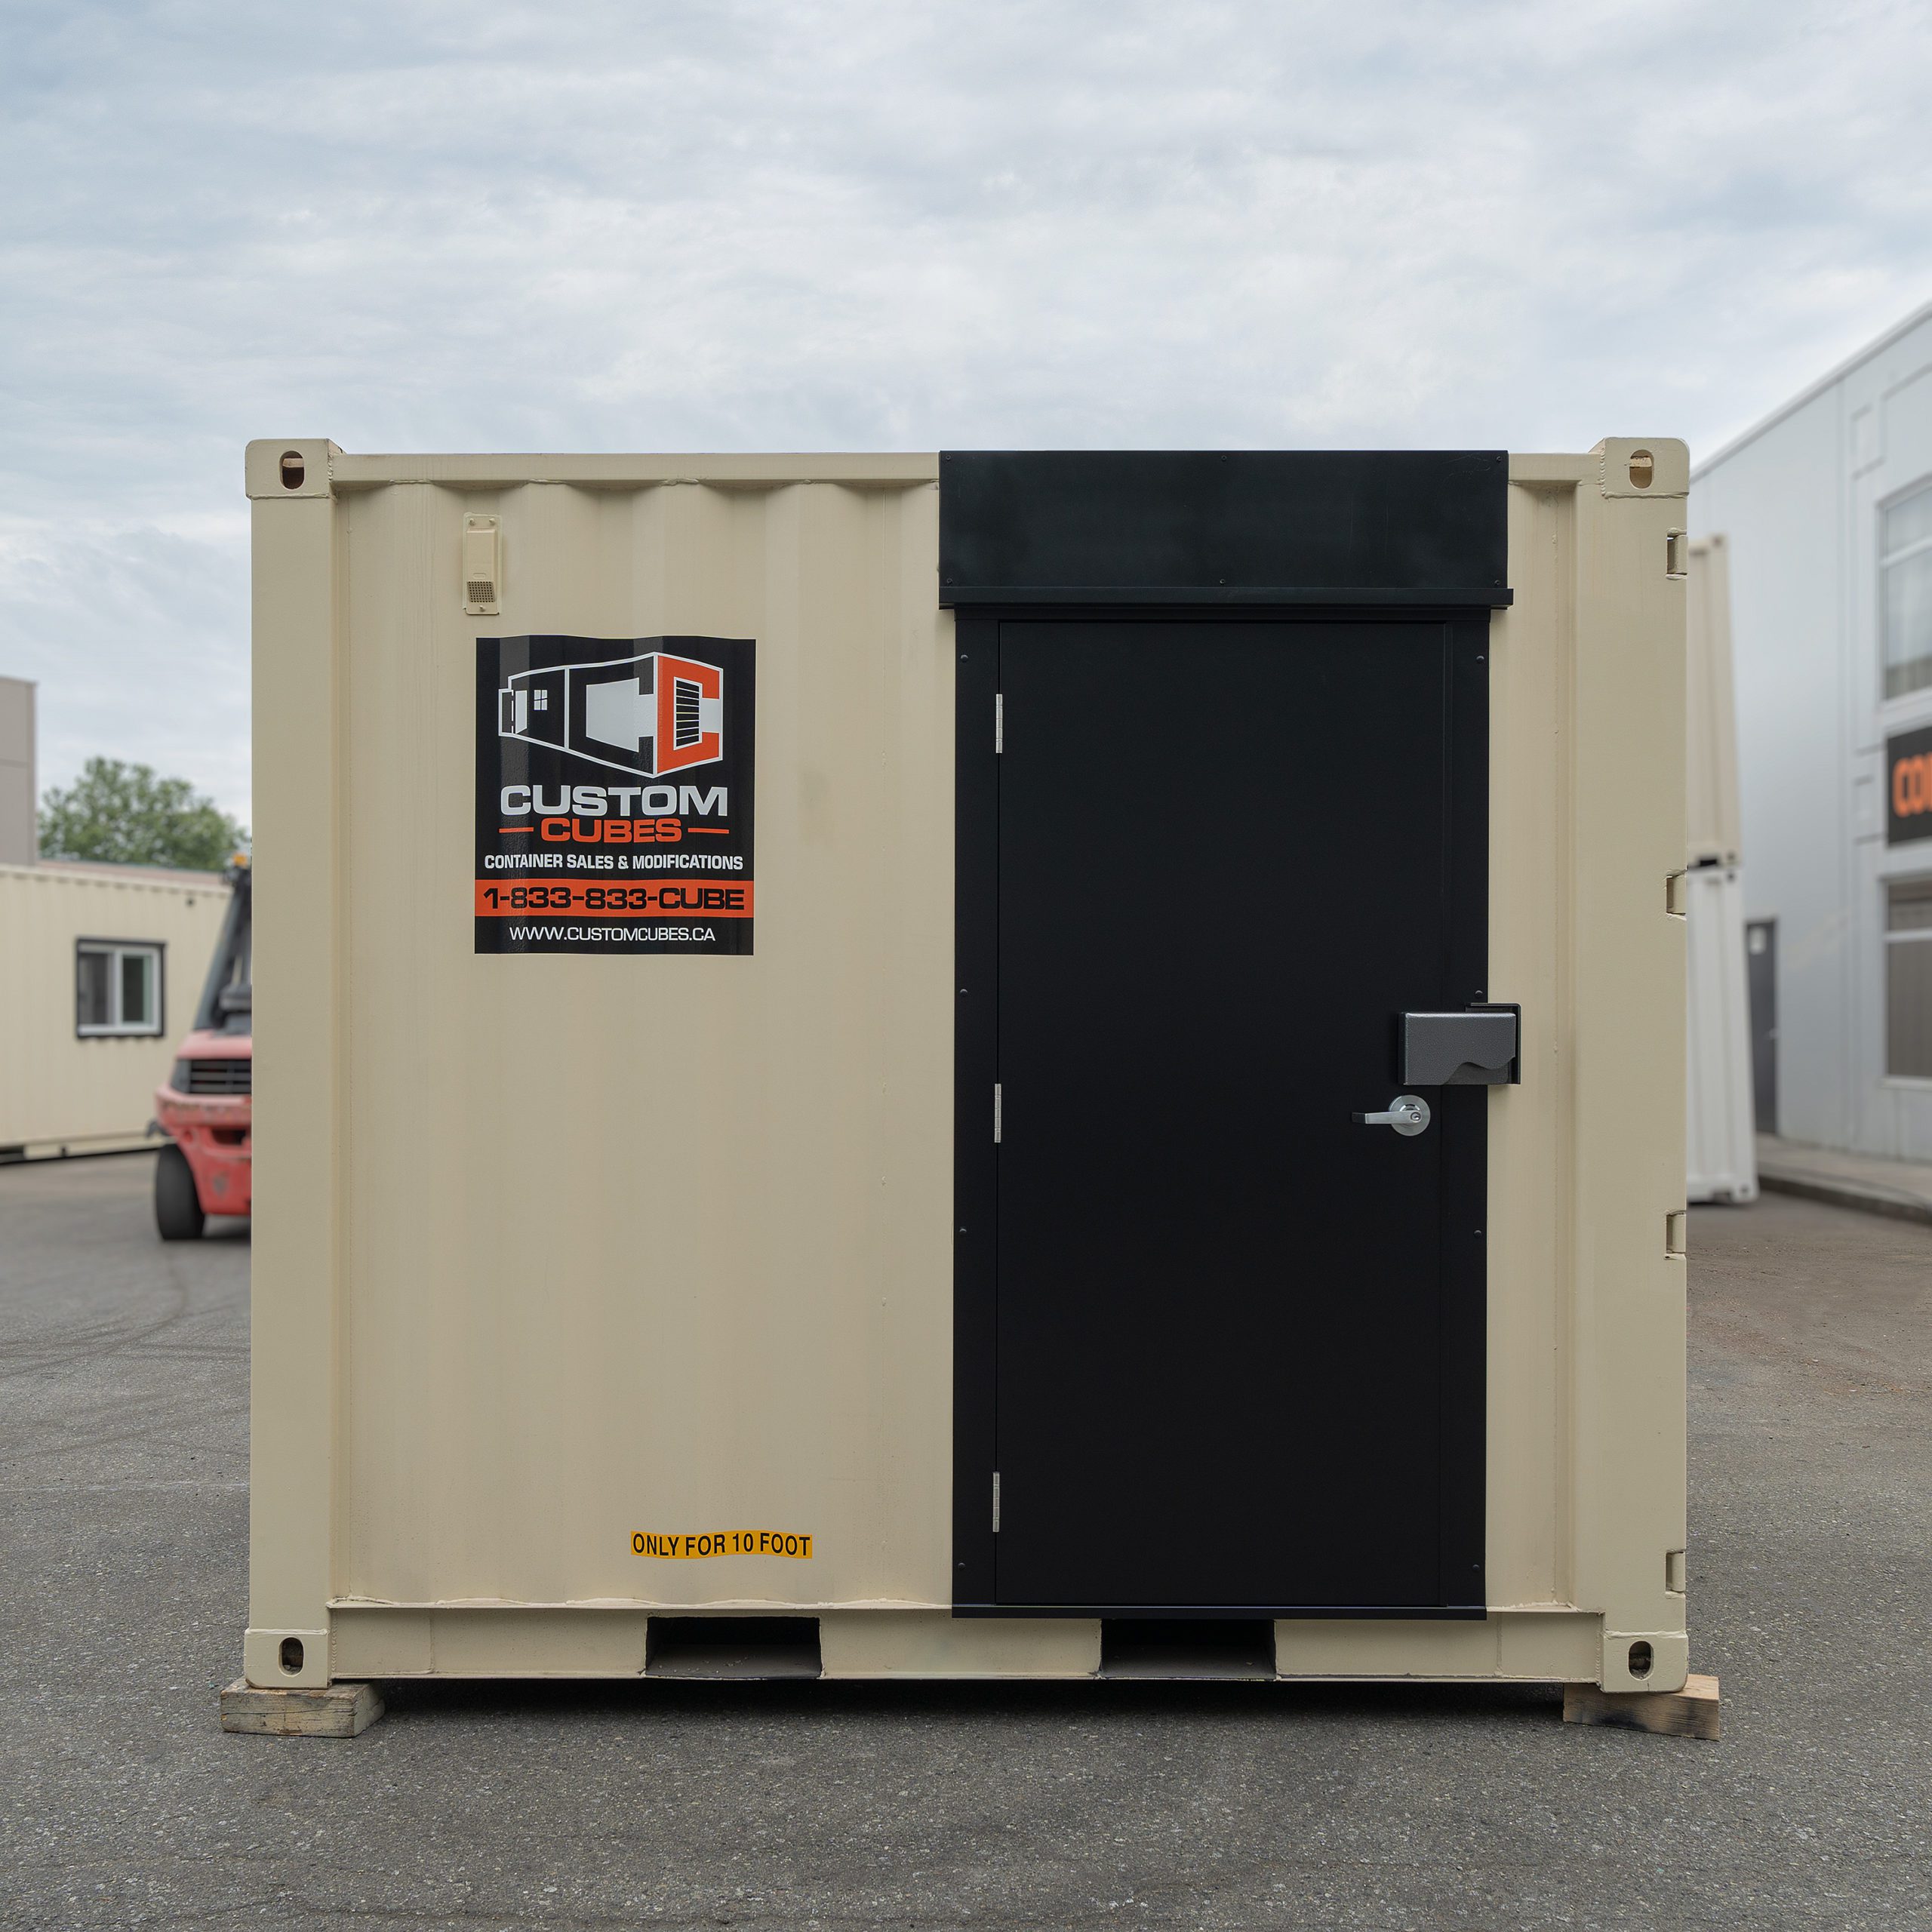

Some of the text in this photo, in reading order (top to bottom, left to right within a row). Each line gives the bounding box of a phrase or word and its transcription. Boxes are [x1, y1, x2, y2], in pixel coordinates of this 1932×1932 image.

[500, 785, 728, 817] CUSTOM
[541, 817, 682, 843] CUBES
[485, 854, 743, 869] CONTAINER SALES & MODIFICATIONS
[483, 887, 745, 910] 1-833-833-CUBE
[509, 926, 715, 942] WWW.CUSTOMCUBES.CA
[632, 1532, 811, 1556] ONLY FOR 10 FOOT
